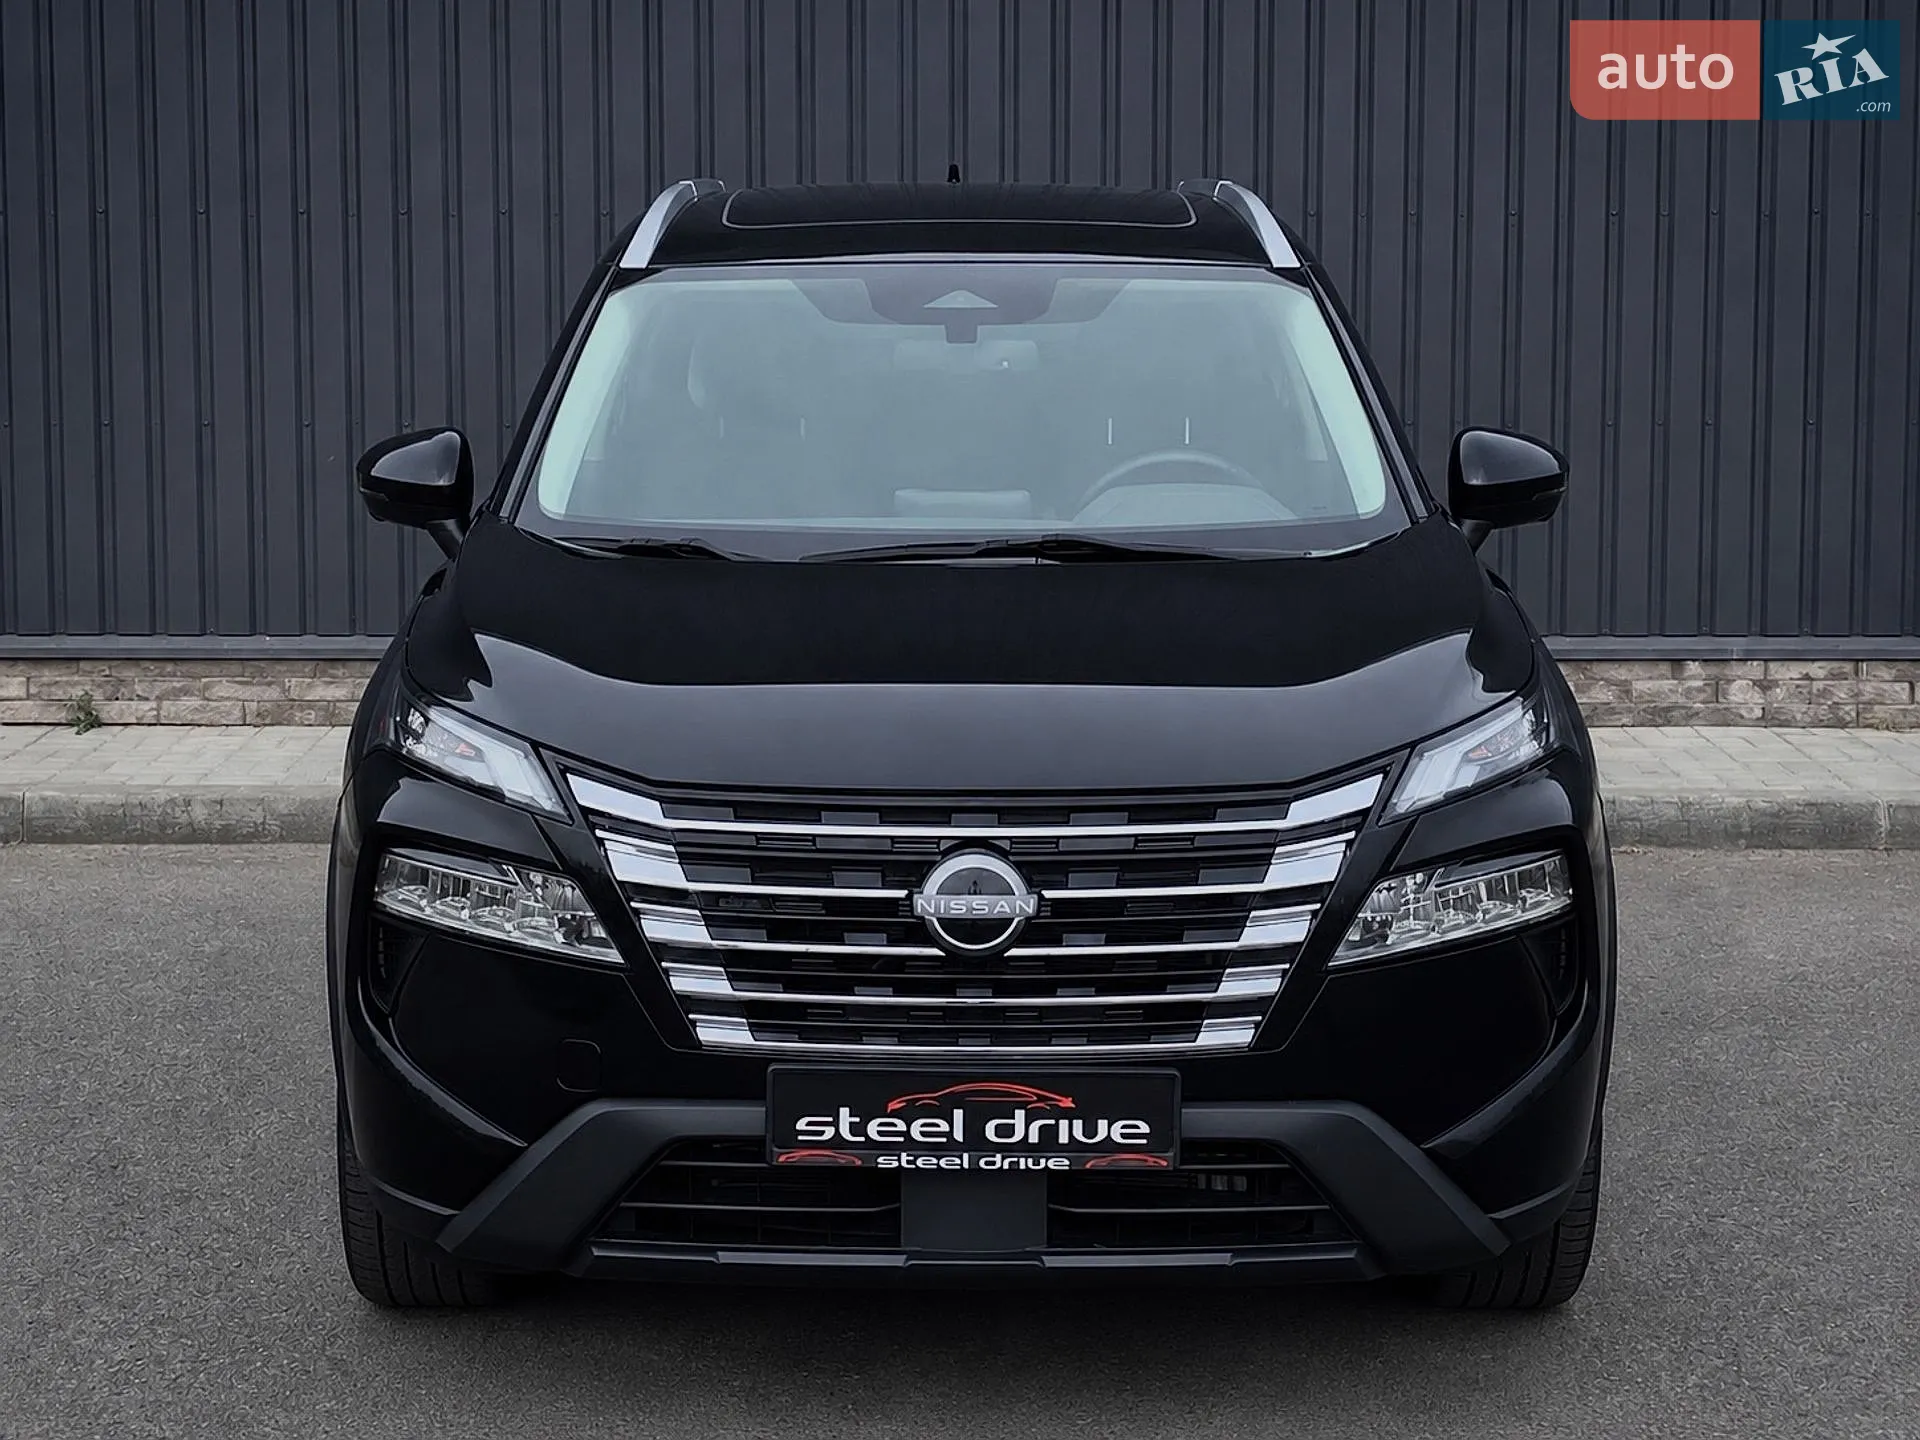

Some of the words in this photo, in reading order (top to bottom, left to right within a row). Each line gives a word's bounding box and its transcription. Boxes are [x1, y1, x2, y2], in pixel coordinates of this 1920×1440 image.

[917, 898, 1034, 914] NISSAN
[795, 1107, 964, 1143] steel
[985, 1109, 1151, 1144] drive
[877, 1152, 969, 1169] steel
[979, 1152, 1070, 1170] drive
